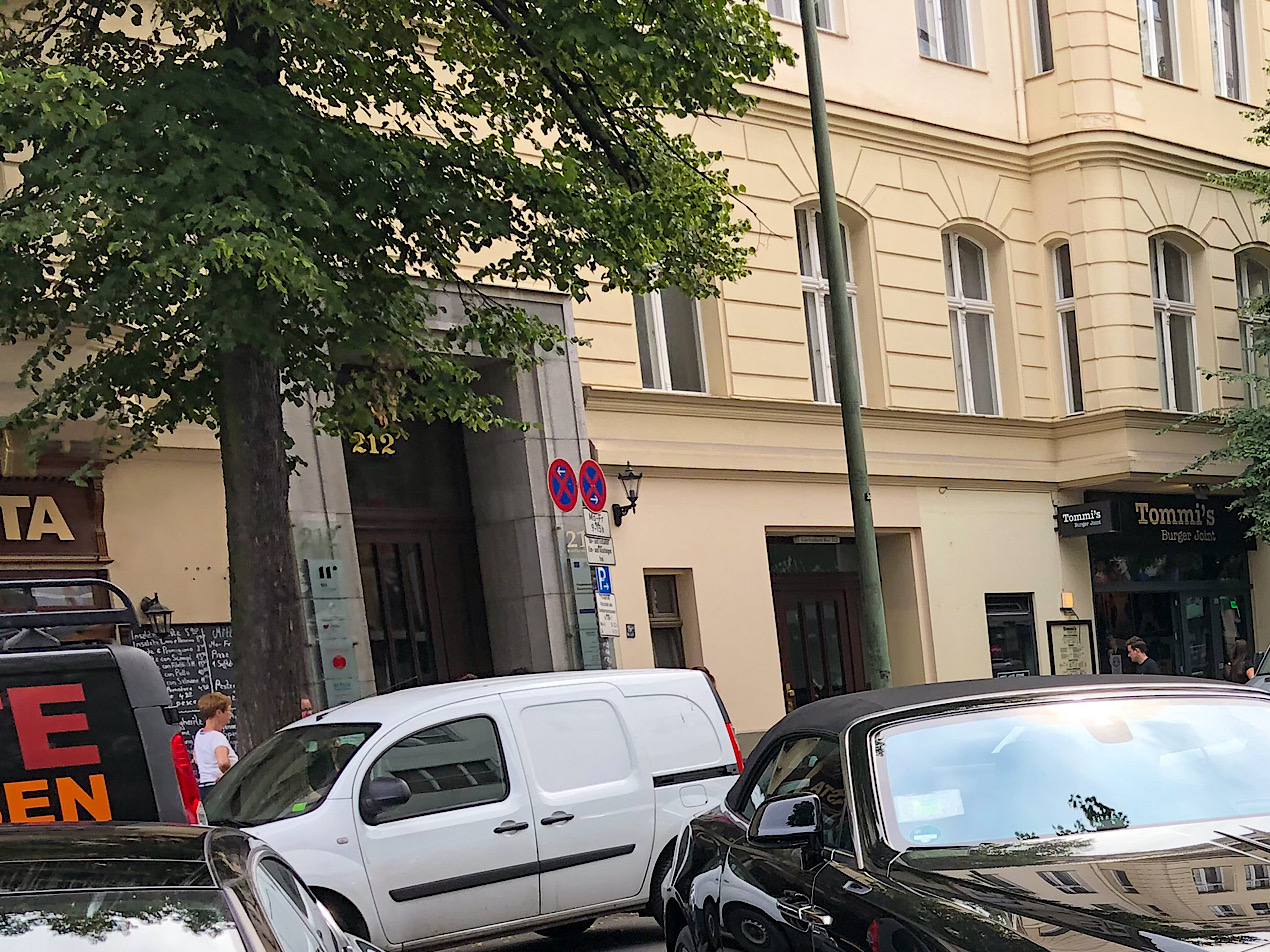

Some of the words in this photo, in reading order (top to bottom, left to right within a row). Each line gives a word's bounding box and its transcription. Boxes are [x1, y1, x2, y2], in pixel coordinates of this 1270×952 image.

[352, 431, 396, 455] 212
[1062, 509, 1102, 523] Tommi's
[1135, 502, 1216, 526] Tommi's
[1160, 529, 1192, 543] Burger
[1194, 529, 1217, 542] Joint
[0, 683, 102, 771] E
[0, 774, 113, 824] EN
